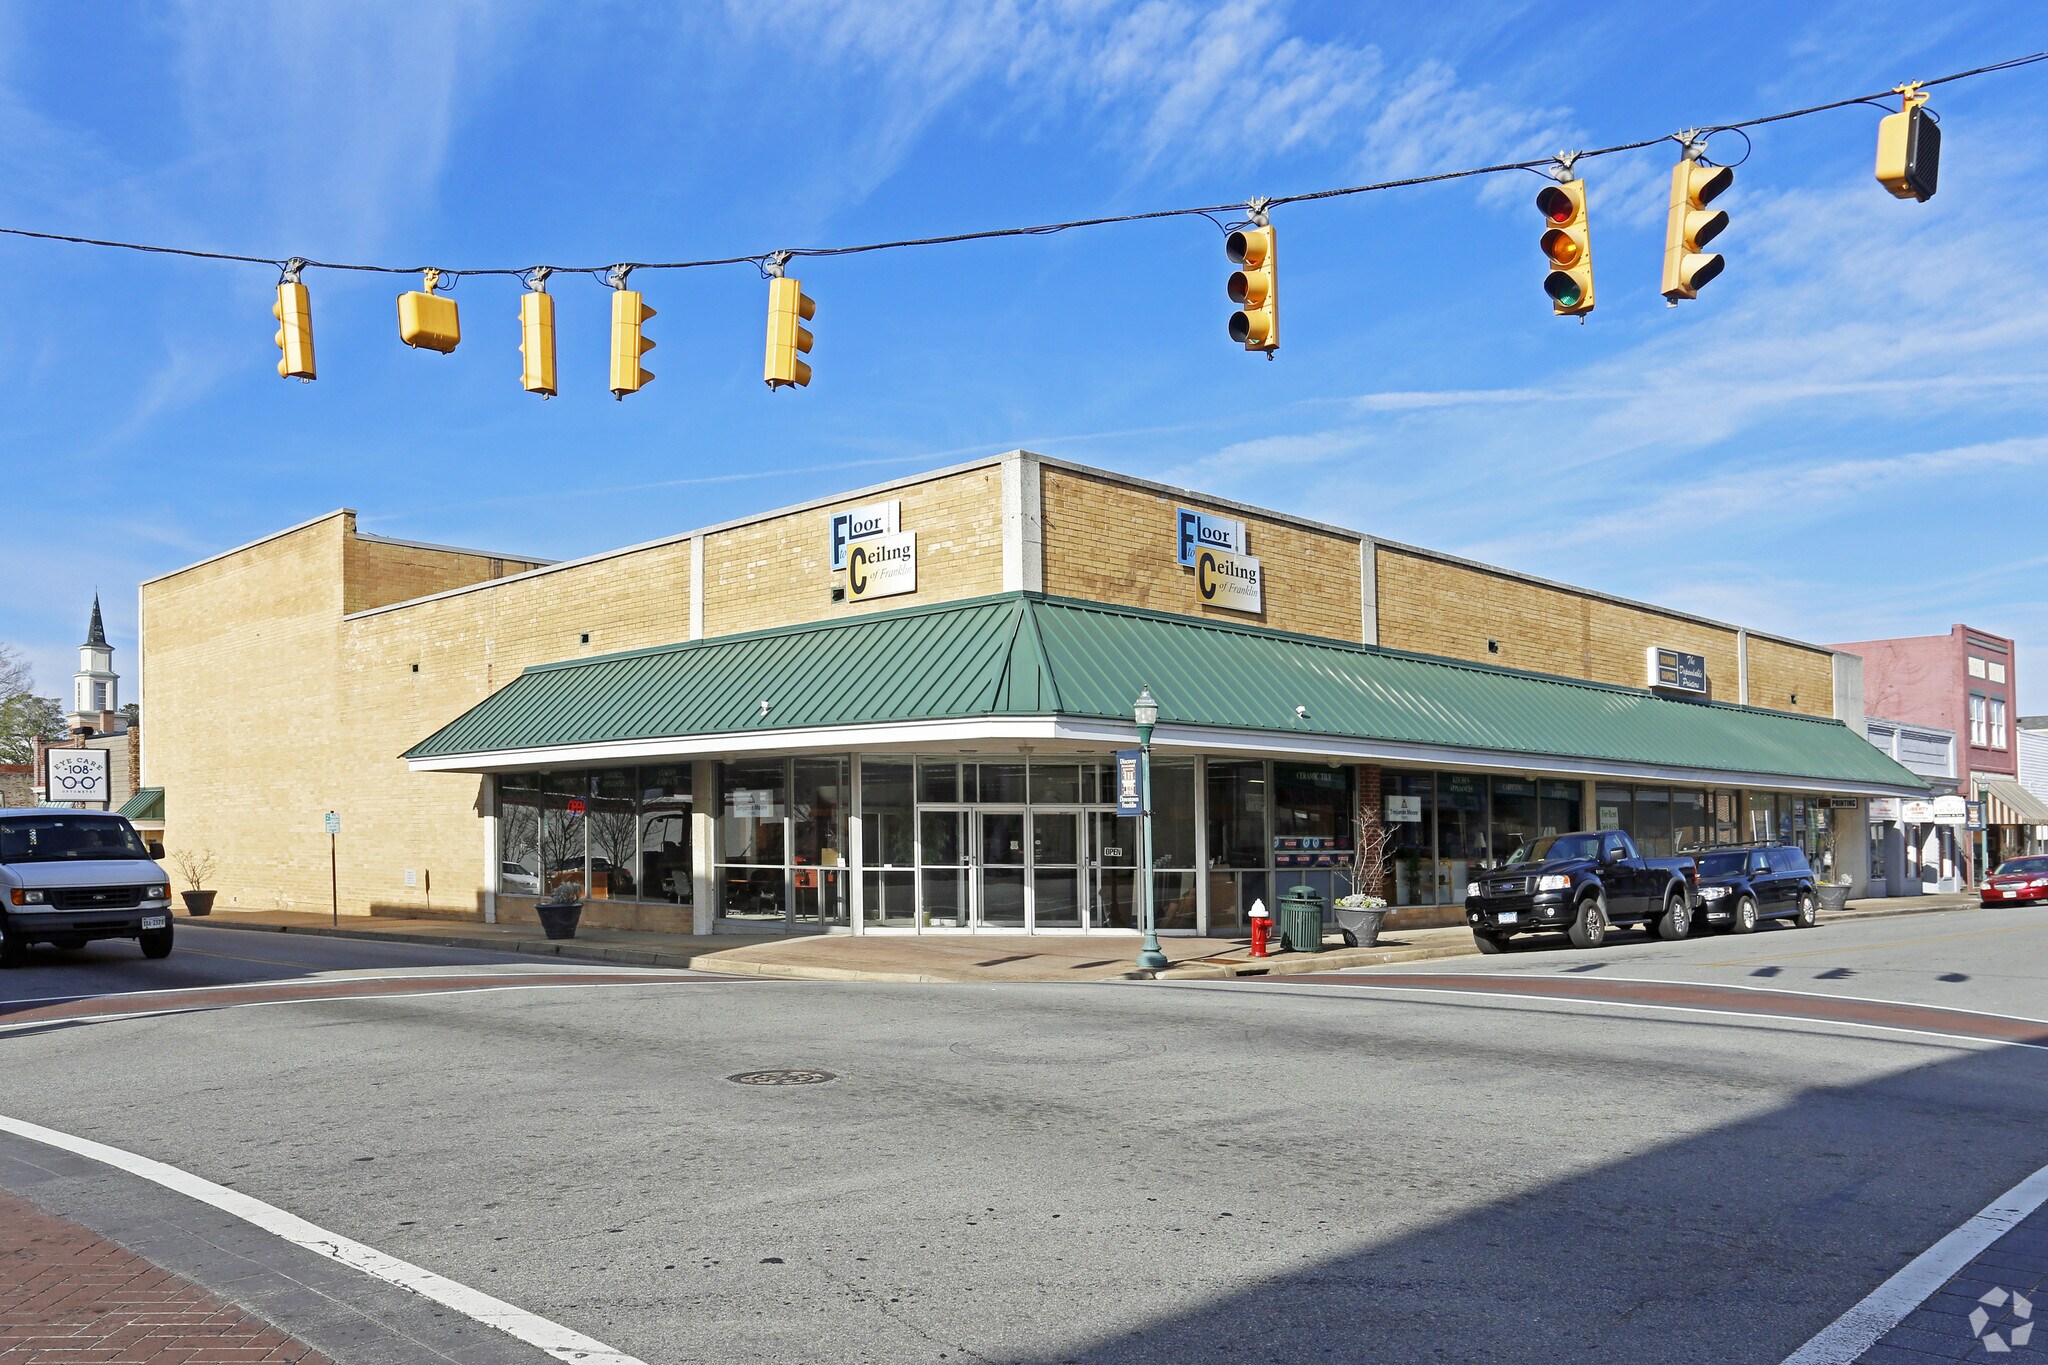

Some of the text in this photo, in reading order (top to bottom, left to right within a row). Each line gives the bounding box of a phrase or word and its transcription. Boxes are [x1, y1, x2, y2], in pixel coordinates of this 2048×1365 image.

[850, 545, 911, 594] Ceiling
[1199, 552, 1256, 599] Ceiling
[1228, 583, 1258, 597] Franklin
[54, 757, 103, 771] EYE CARE
[1296, 772, 1332, 781] CERAMIC TILE
[1105, 848, 1121, 857] OPEN
